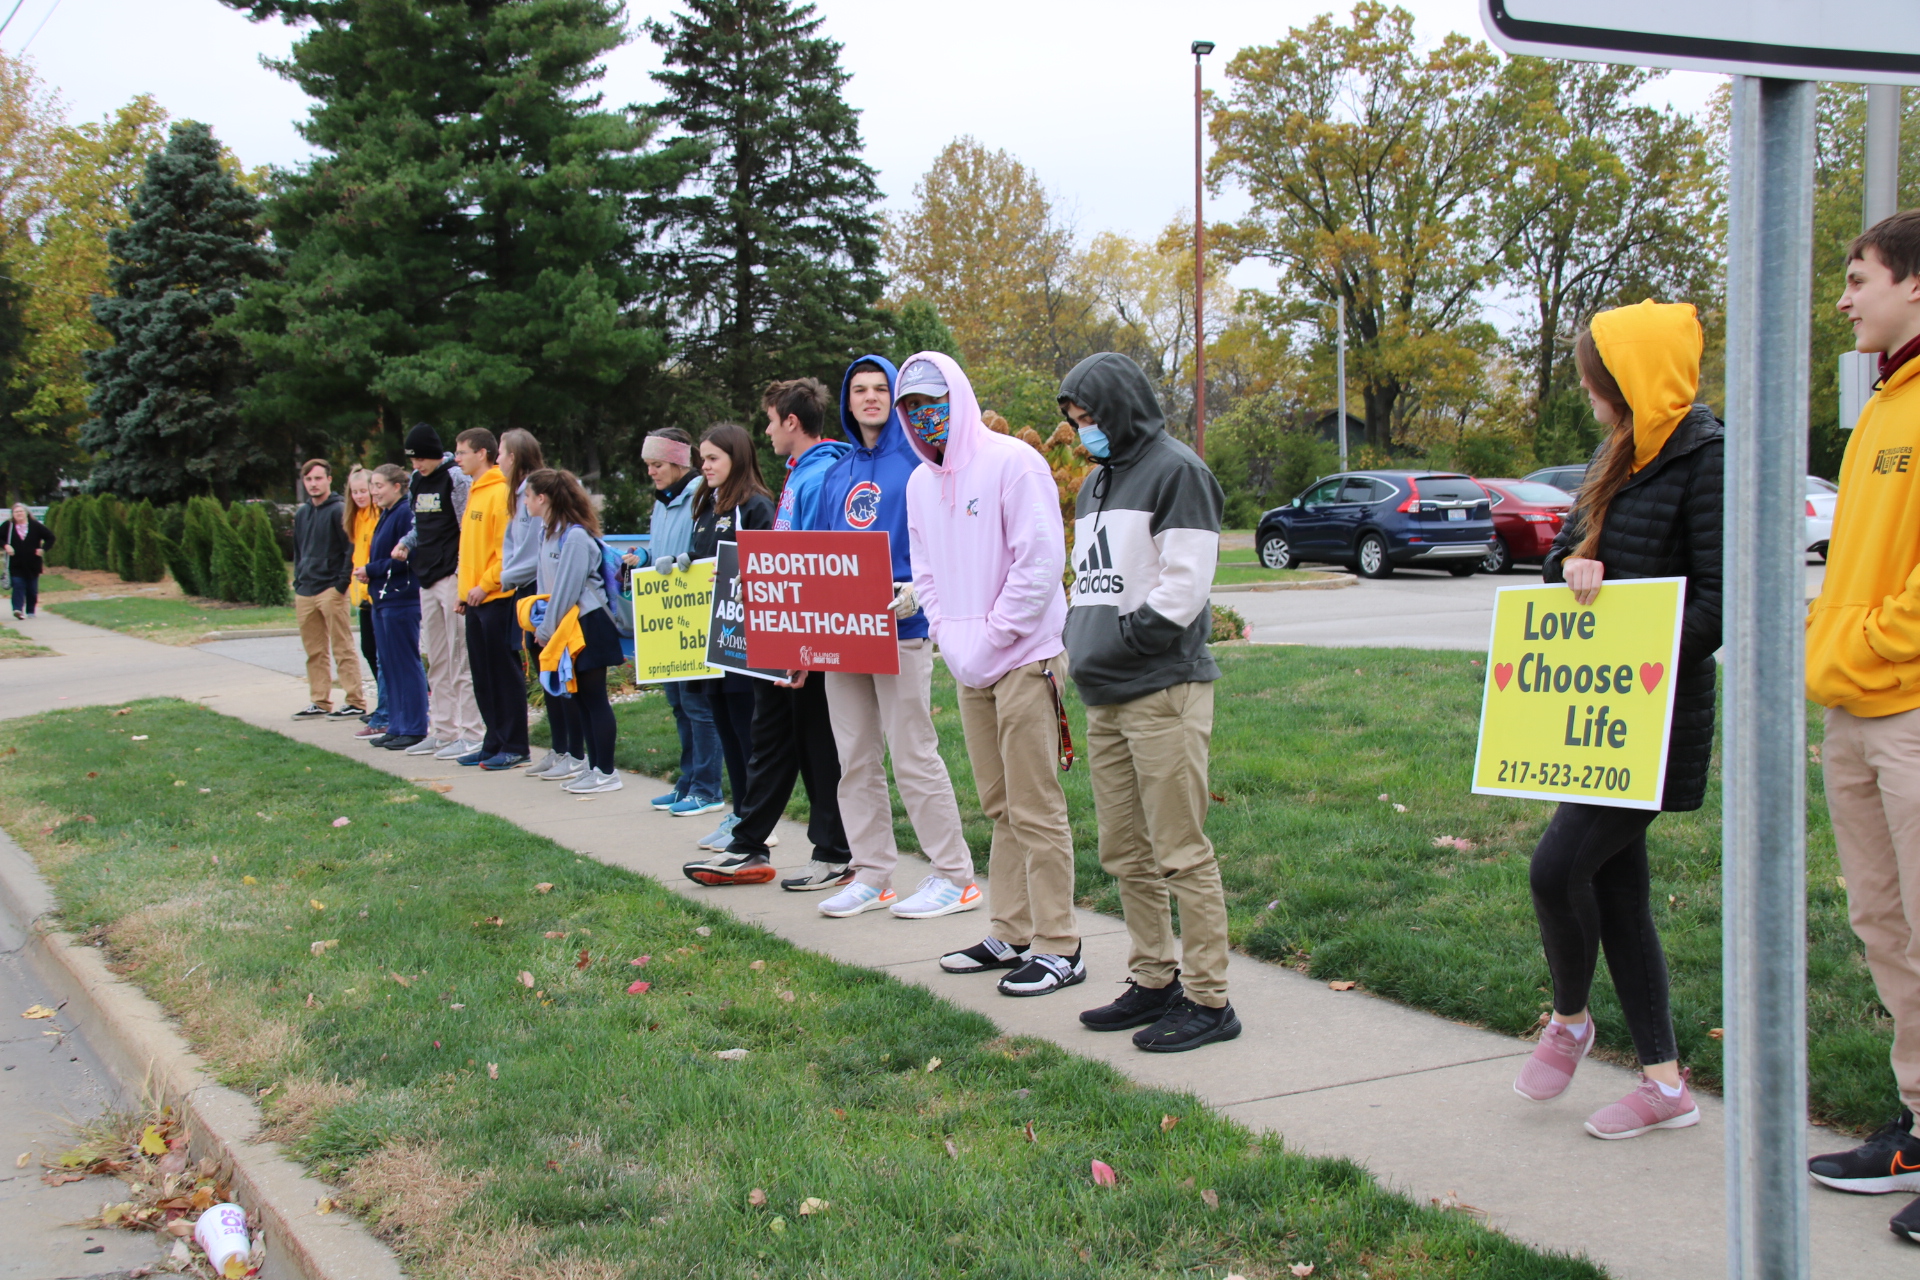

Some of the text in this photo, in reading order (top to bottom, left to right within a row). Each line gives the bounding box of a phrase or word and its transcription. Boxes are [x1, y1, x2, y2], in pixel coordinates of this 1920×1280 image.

[746, 552, 859, 577] ABORTION
[637, 577, 688, 596] Love the
[747, 580, 802, 604] ISN'T
[1076, 569, 1124, 595] didas
[661, 589, 713, 610] woman
[715, 599, 745, 623] ABO
[640, 614, 690, 633] Love the
[749, 610, 890, 637] HEALTHCARE
[1523, 601, 1596, 641] Love
[679, 628, 708, 650] bab
[648, 659, 711, 678] springfieldrtl.org
[1517, 652, 1634, 695] Choose
[1564, 705, 1628, 749] Life
[1497, 759, 1631, 792] 217-523-2700
